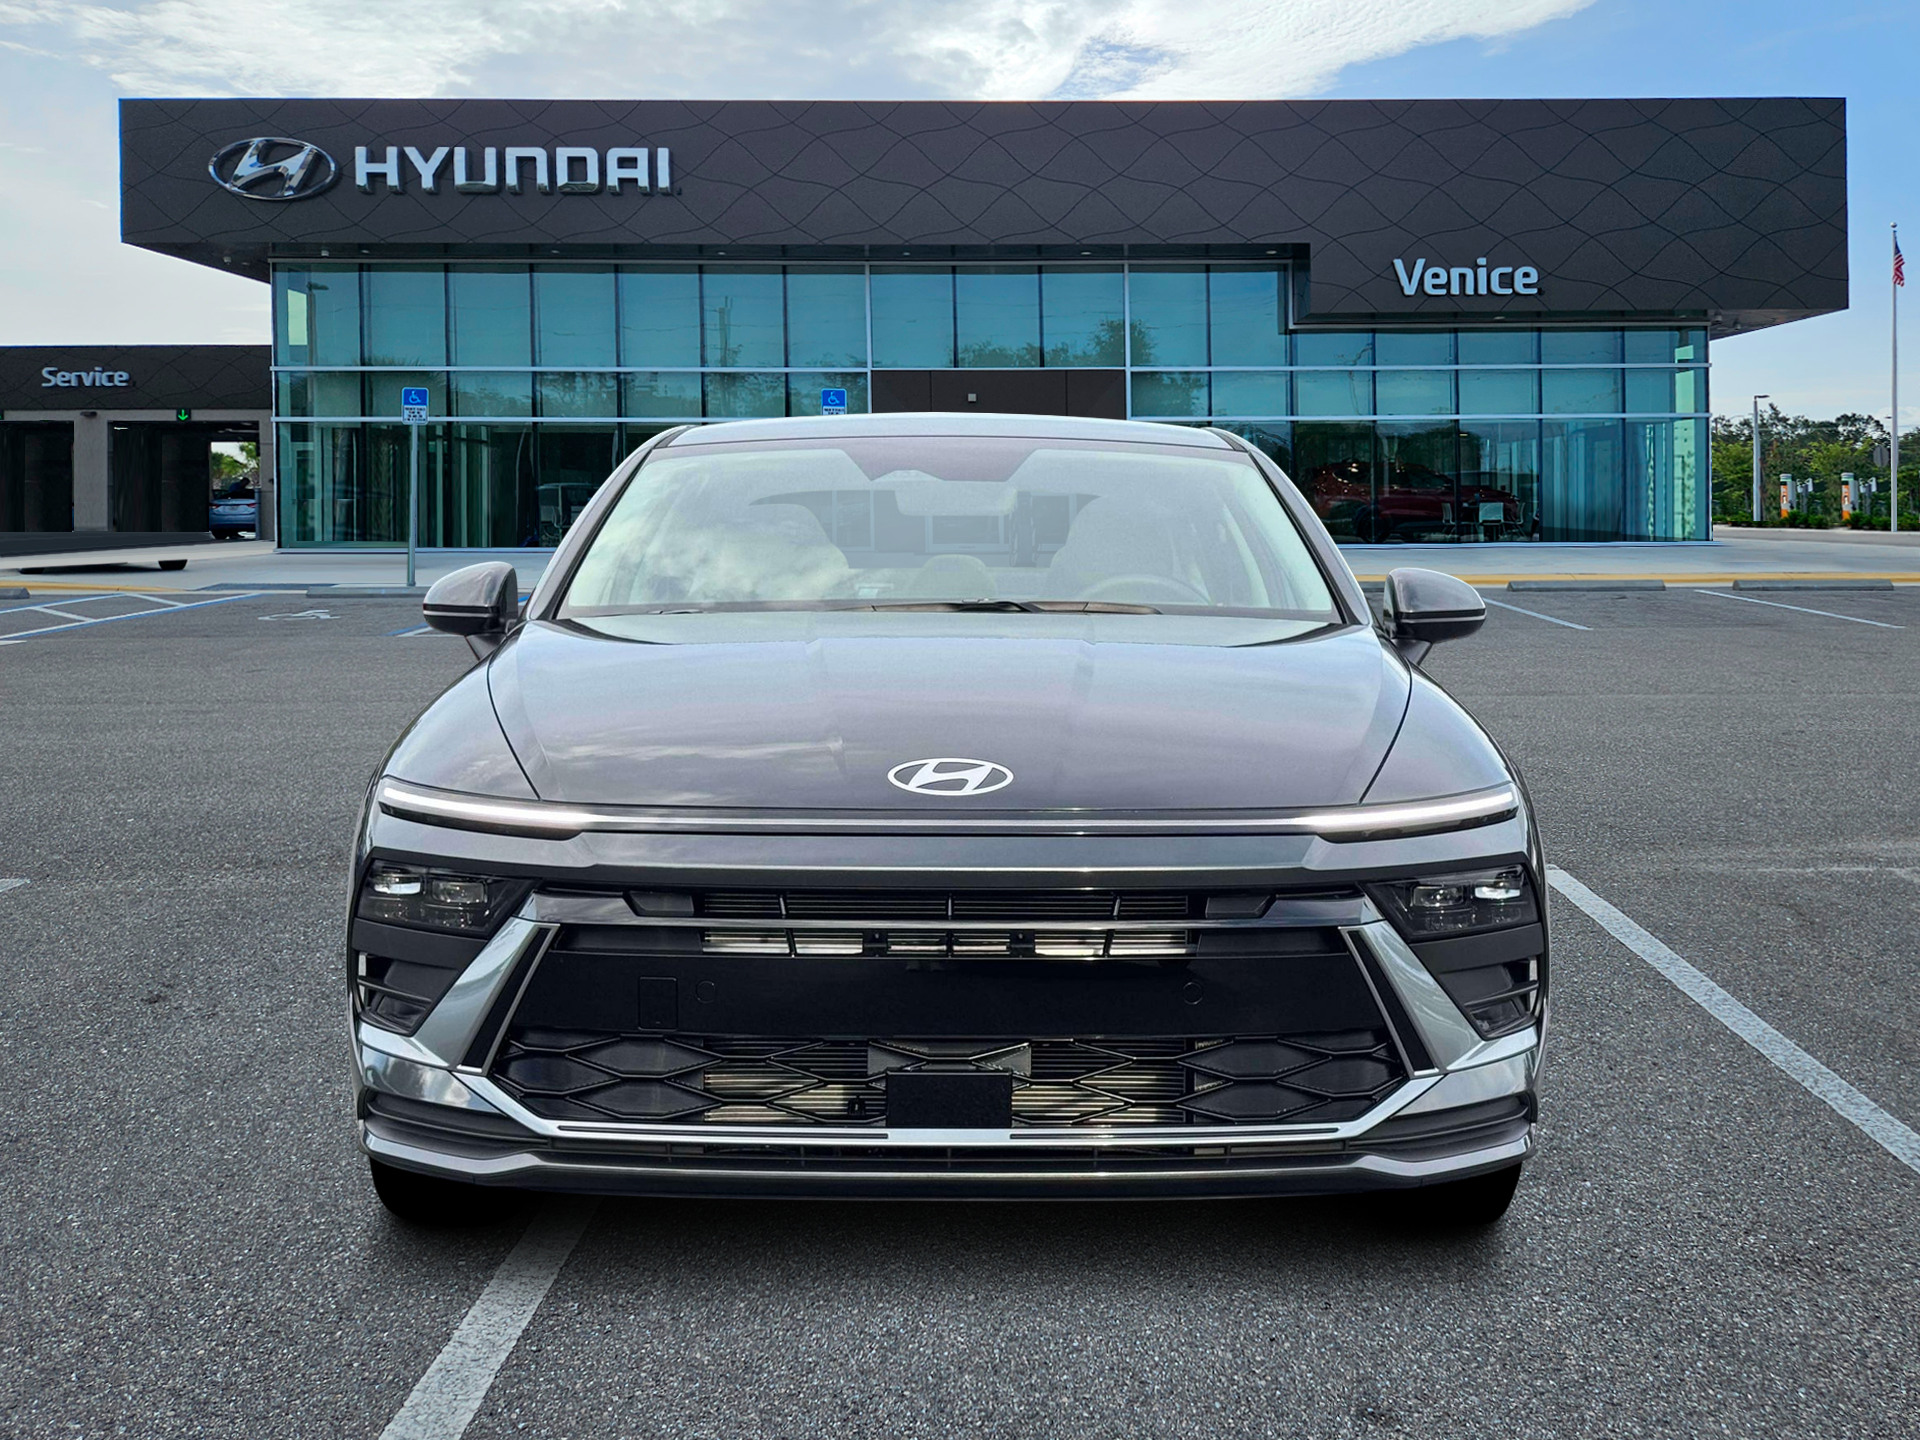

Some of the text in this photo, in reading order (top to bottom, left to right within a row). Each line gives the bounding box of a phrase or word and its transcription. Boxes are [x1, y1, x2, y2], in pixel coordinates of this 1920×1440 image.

[354, 146, 672, 194] HYUNDAI
[1393, 257, 1539, 296] Venice
[41, 366, 130, 387] Service
